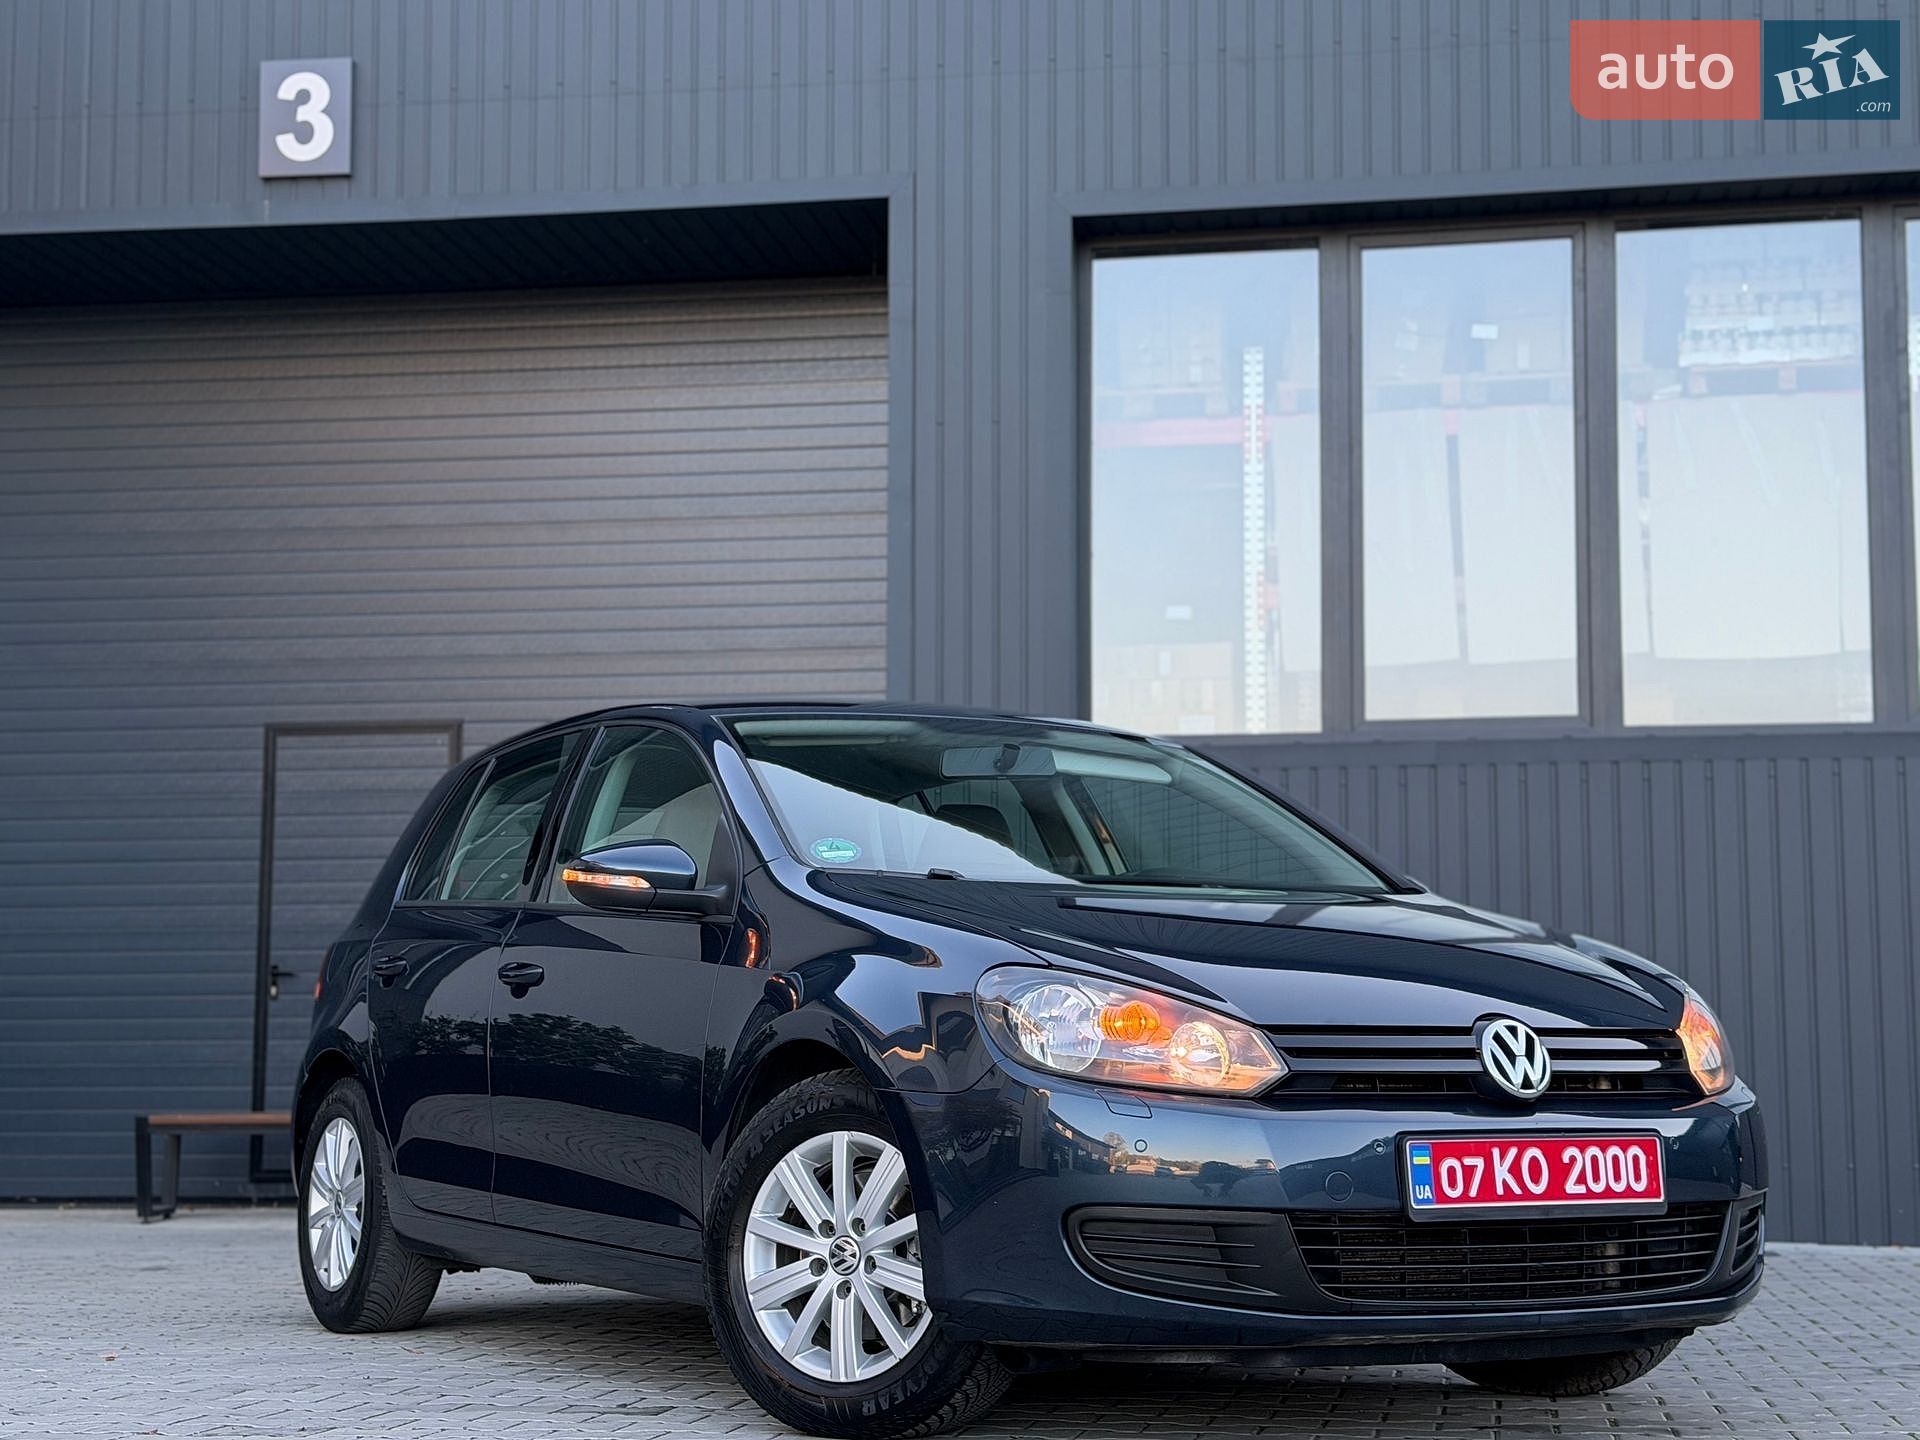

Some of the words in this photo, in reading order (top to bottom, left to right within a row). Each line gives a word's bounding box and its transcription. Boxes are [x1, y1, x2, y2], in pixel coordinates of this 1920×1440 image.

[275, 71, 334, 162] 3
[1415, 1184, 1433, 1200] UA
[1438, 1156, 1485, 1198] 07
[1491, 1146, 1549, 1196] KO
[1561, 1145, 1648, 1194] 2000
